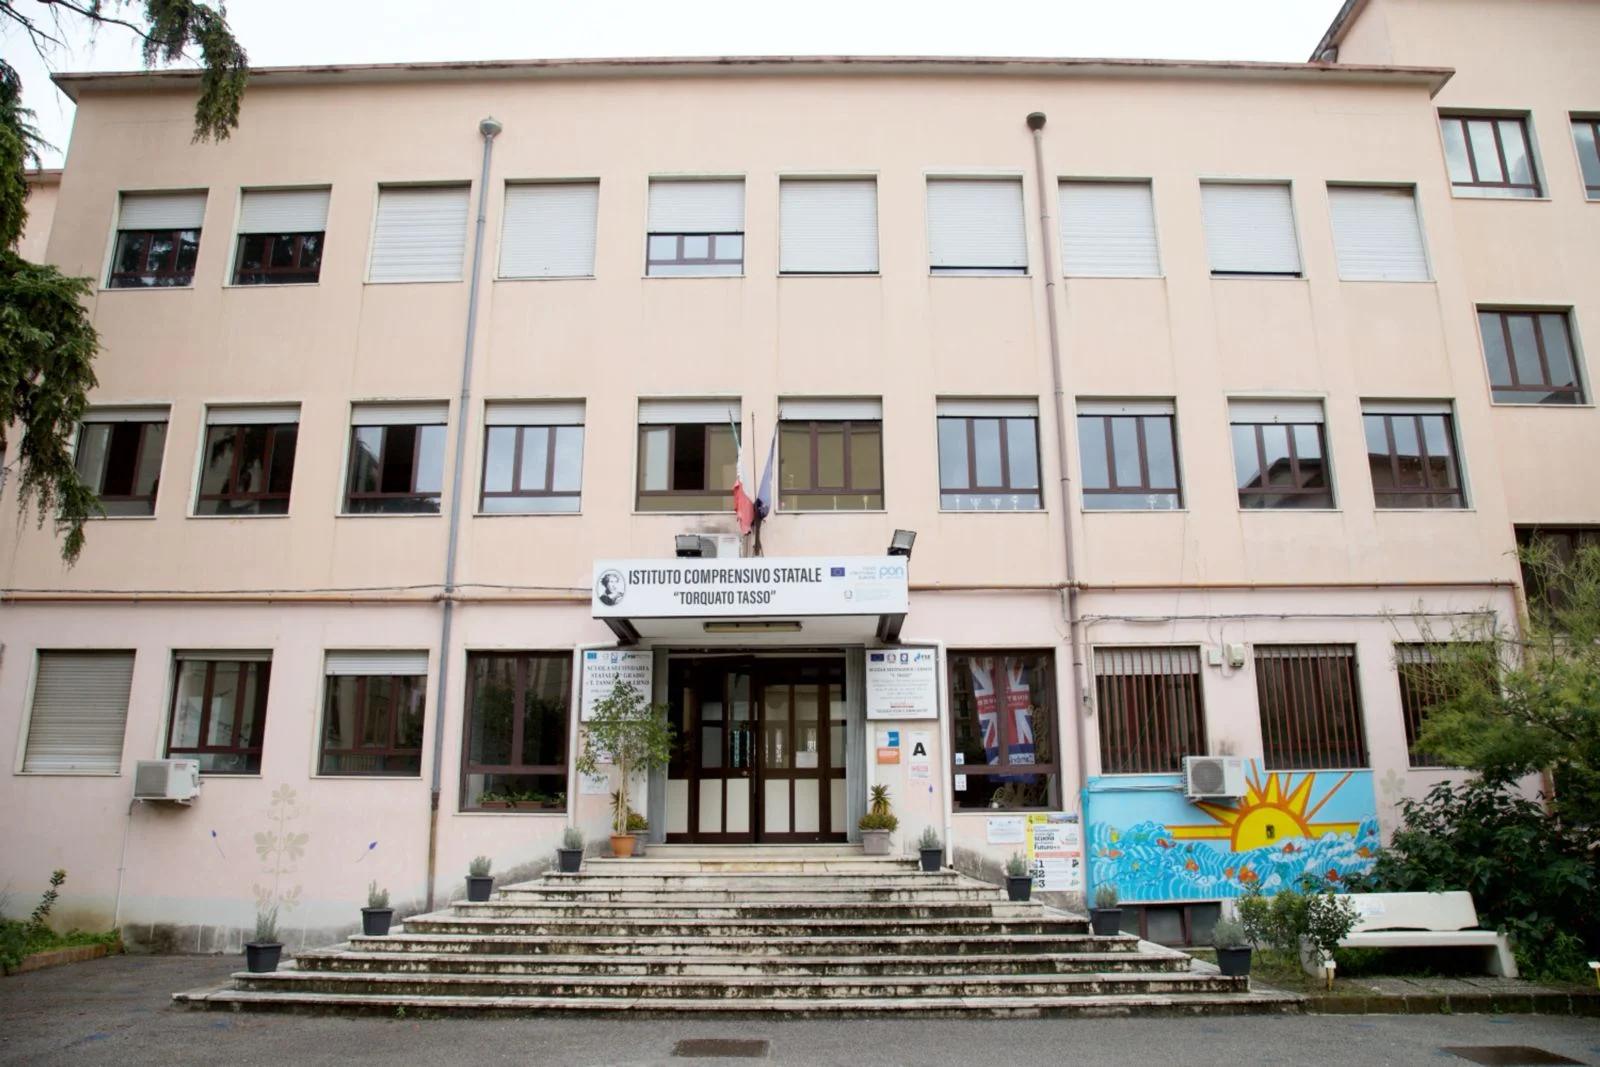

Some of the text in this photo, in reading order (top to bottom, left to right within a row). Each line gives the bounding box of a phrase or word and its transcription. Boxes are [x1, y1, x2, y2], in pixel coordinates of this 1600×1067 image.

[629, 567, 822, 585] ISTITUTO COMPRENSIVO STATALE
[880, 566, 904, 579] pon
[912, 742, 927, 756] A
